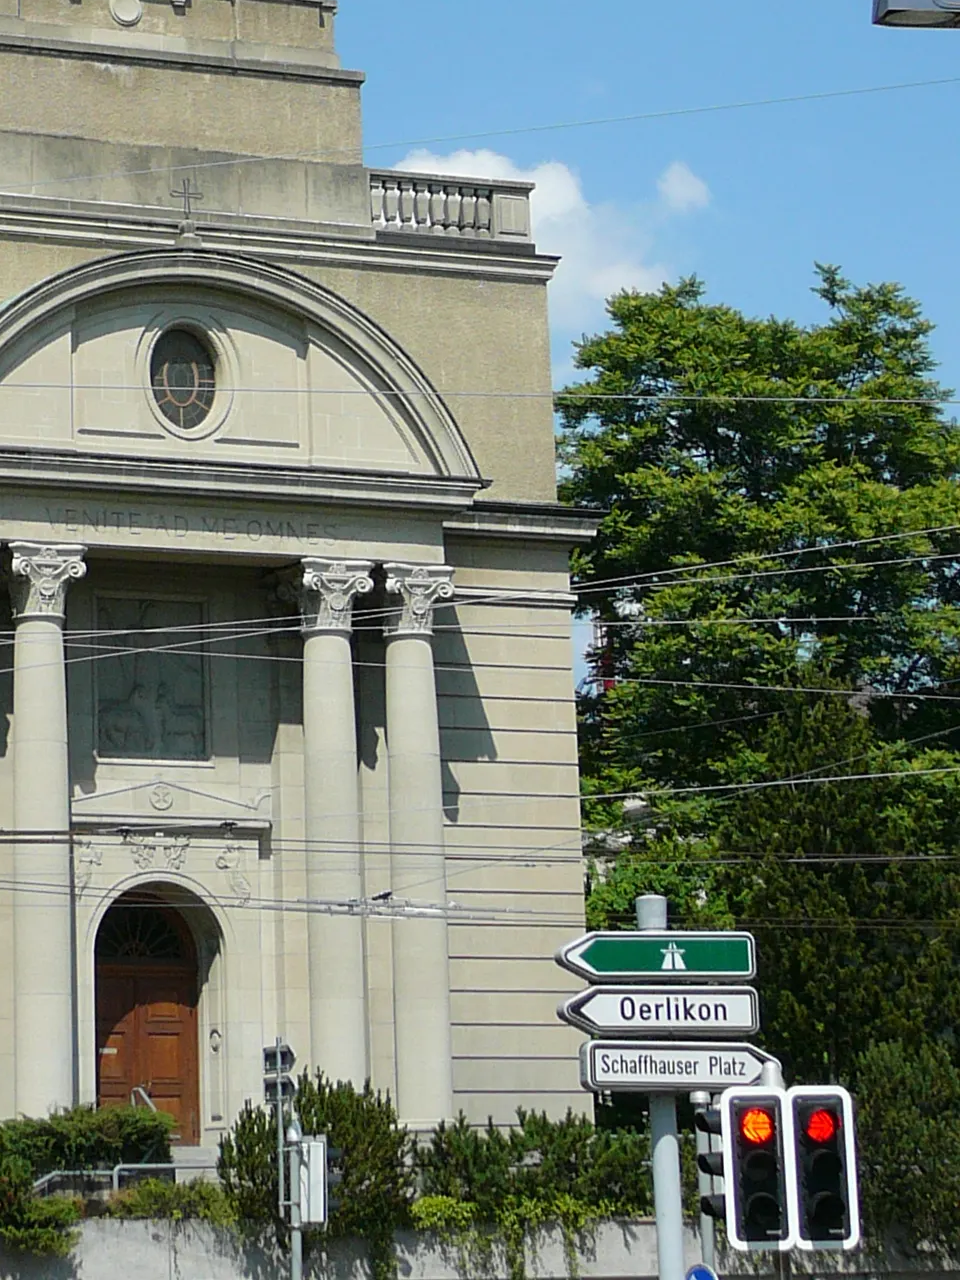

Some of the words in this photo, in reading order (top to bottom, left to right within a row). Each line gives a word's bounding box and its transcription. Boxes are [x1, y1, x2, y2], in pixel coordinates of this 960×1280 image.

[45, 506, 142, 536] VENITE
[153, 513, 189, 538] AD
[201, 516, 236, 540] ME
[246, 519, 340, 546] OMNES
[620, 997, 727, 1020] Oerlikon
[601, 1054, 699, 1075] Schaffhauser
[709, 1056, 746, 1076] Platz
